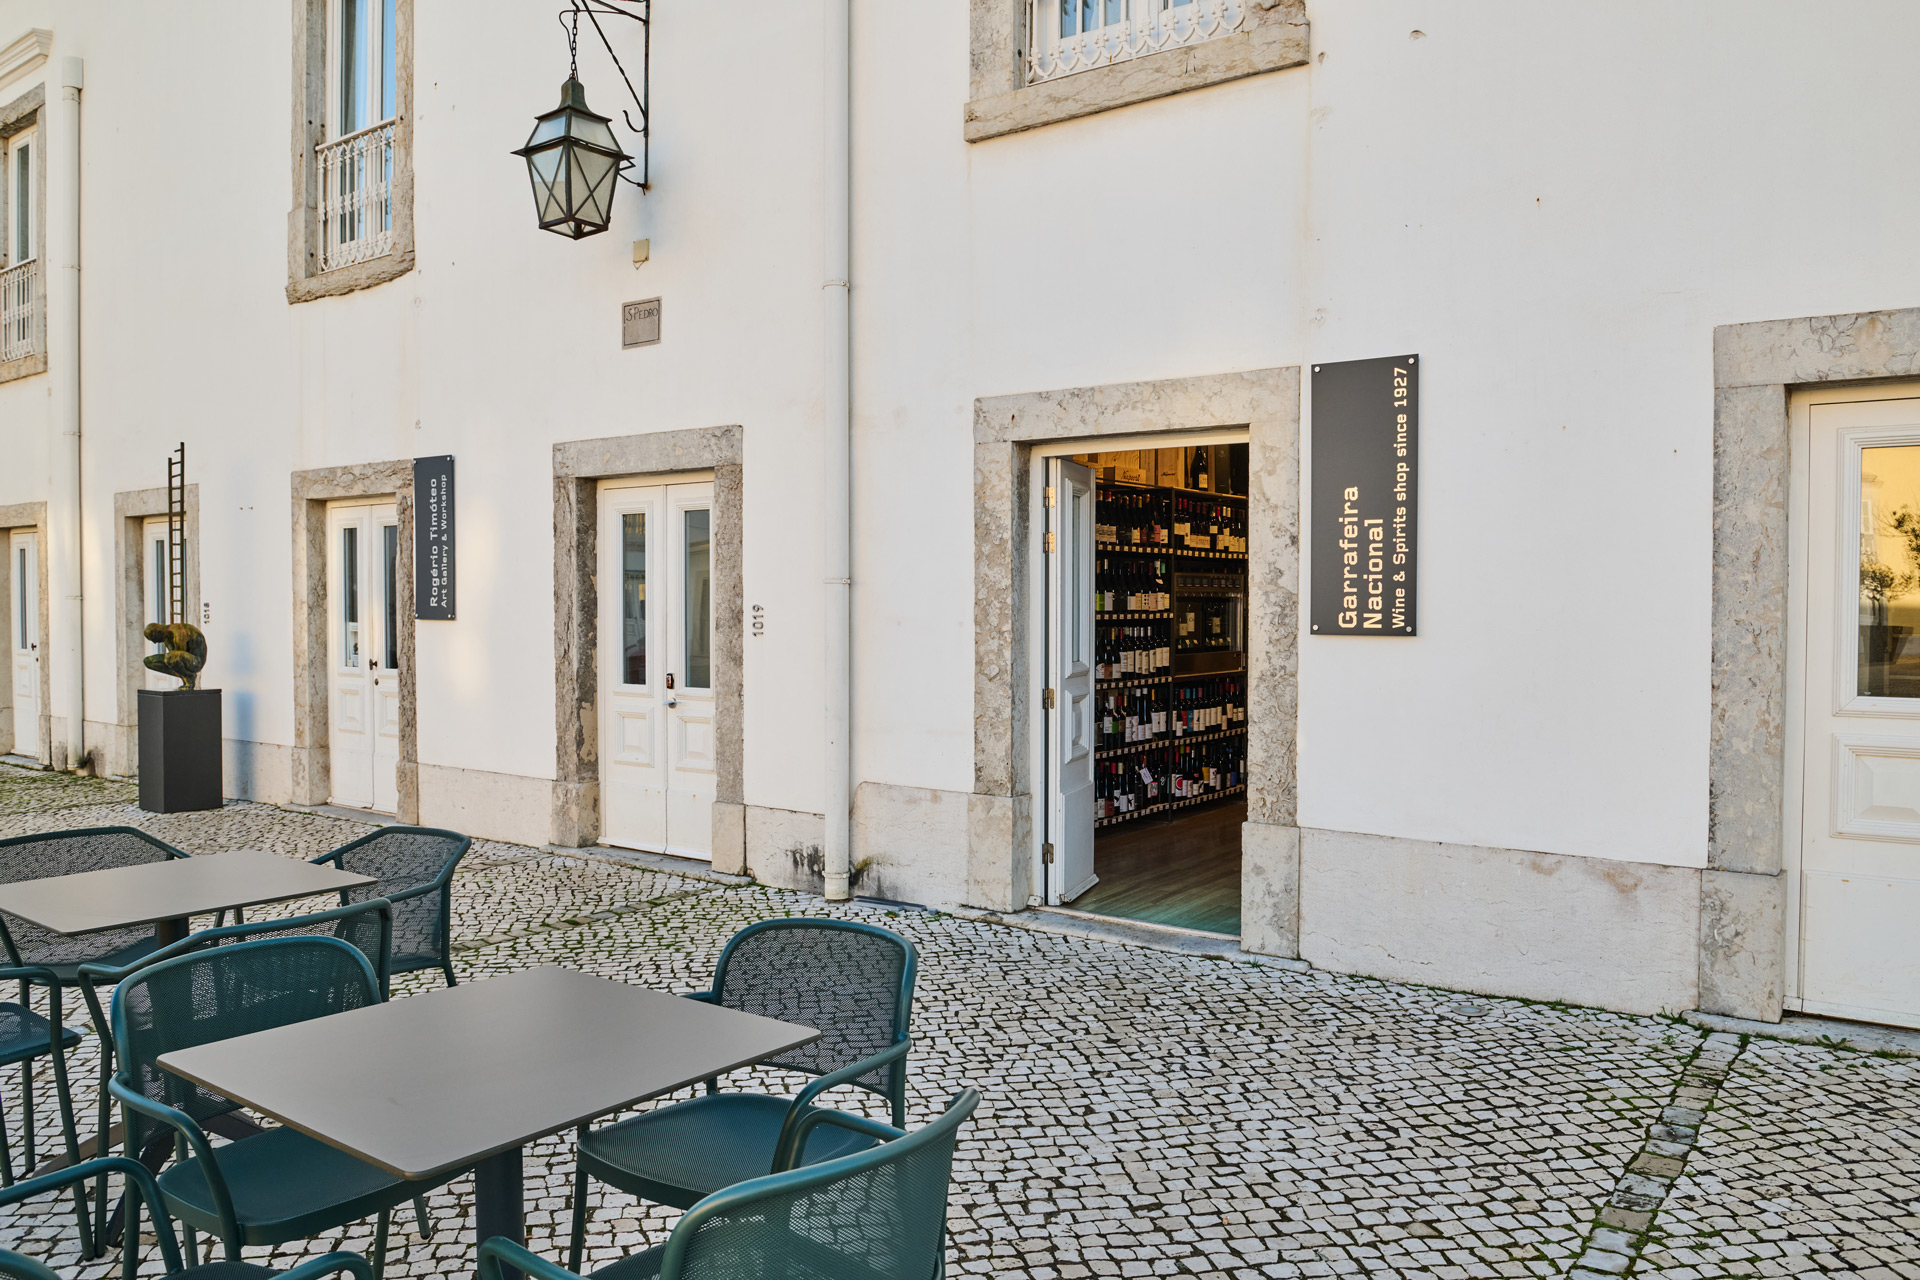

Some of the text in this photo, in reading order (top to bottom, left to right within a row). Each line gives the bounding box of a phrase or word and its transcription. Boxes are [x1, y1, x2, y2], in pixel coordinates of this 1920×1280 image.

[430, 478, 440, 607] Rogério Timóteo
[441, 533, 448, 541] &
[1392, 367, 1410, 629] Wine & Spirits shop since 1927
[441, 545, 449, 585] Gallery
[1338, 486, 1358, 629] Garrafeira
[1363, 518, 1383, 629] Nacional
[752, 604, 764, 637] 1019
